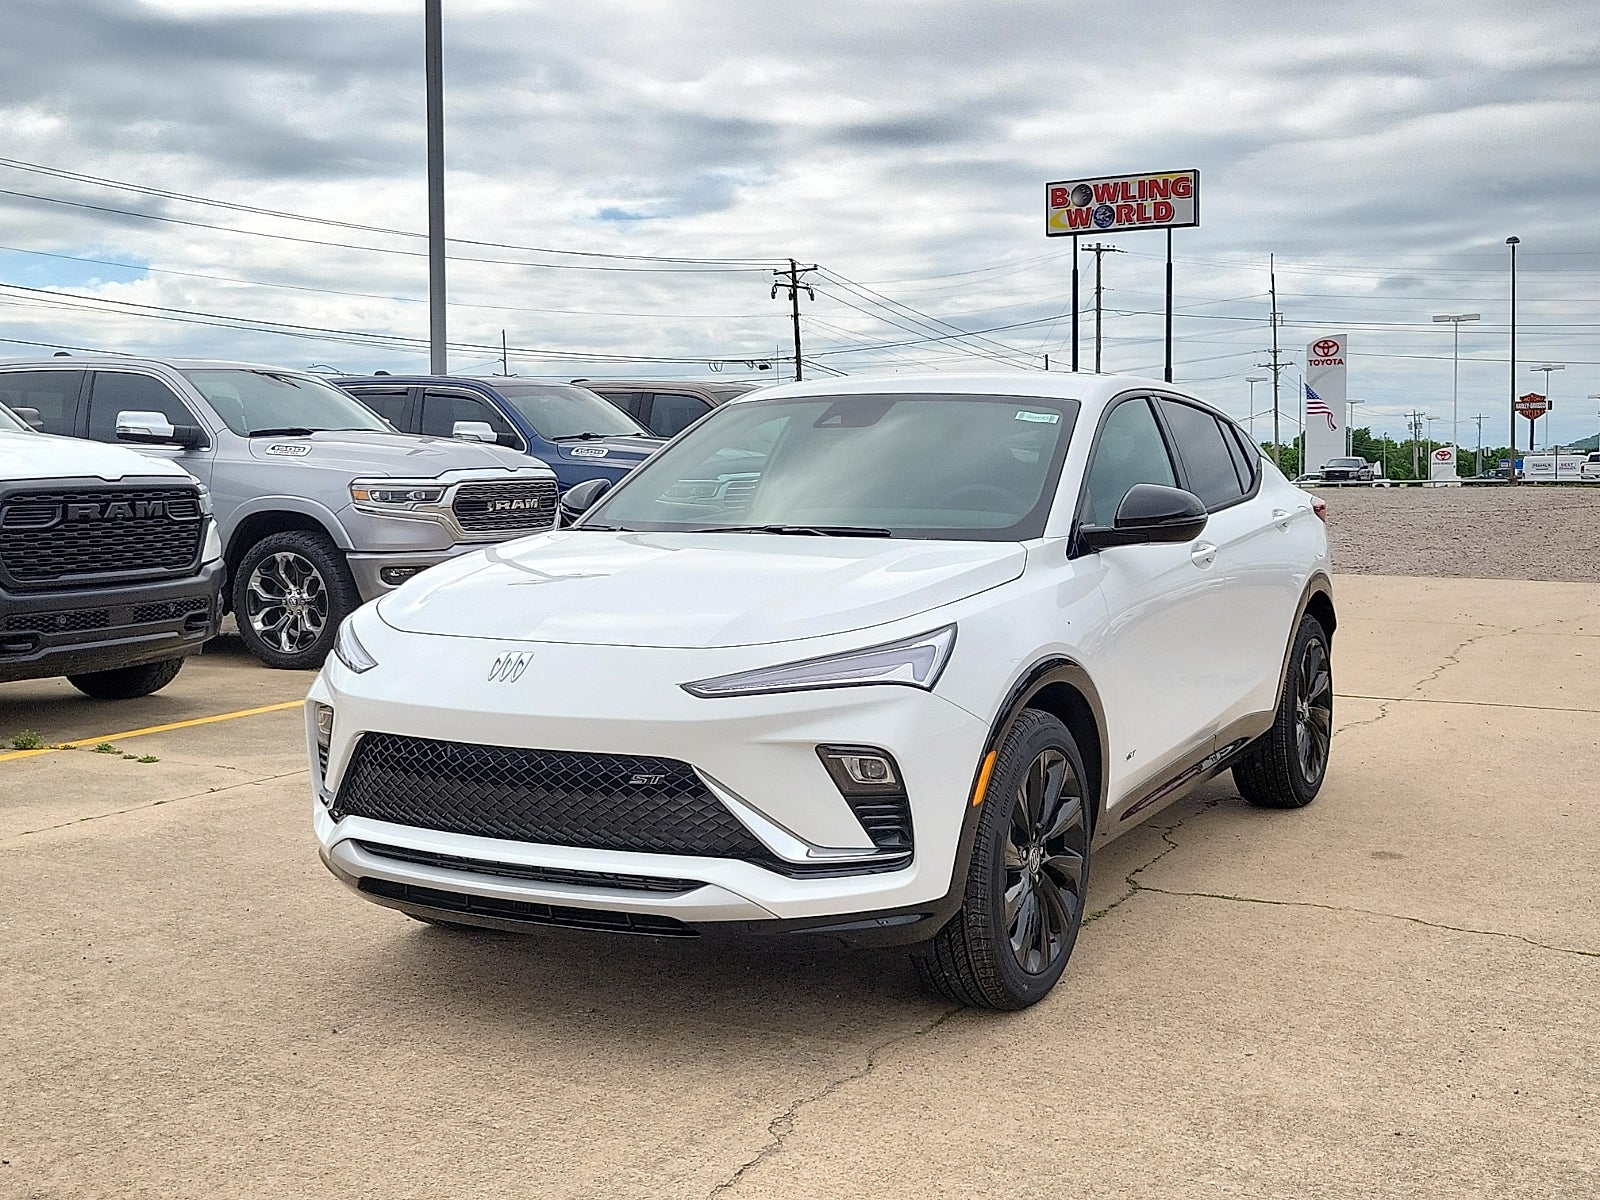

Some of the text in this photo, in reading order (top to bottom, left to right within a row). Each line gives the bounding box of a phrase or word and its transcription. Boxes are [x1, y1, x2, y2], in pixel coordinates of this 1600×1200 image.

[1051, 176, 1192, 208] BOWLING
[1066, 201, 1175, 229] WORLD
[1308, 358, 1344, 366] TOYOTA
[67, 500, 163, 520] RAM
[495, 498, 539, 510] RAM
[628, 774, 665, 785] ST
